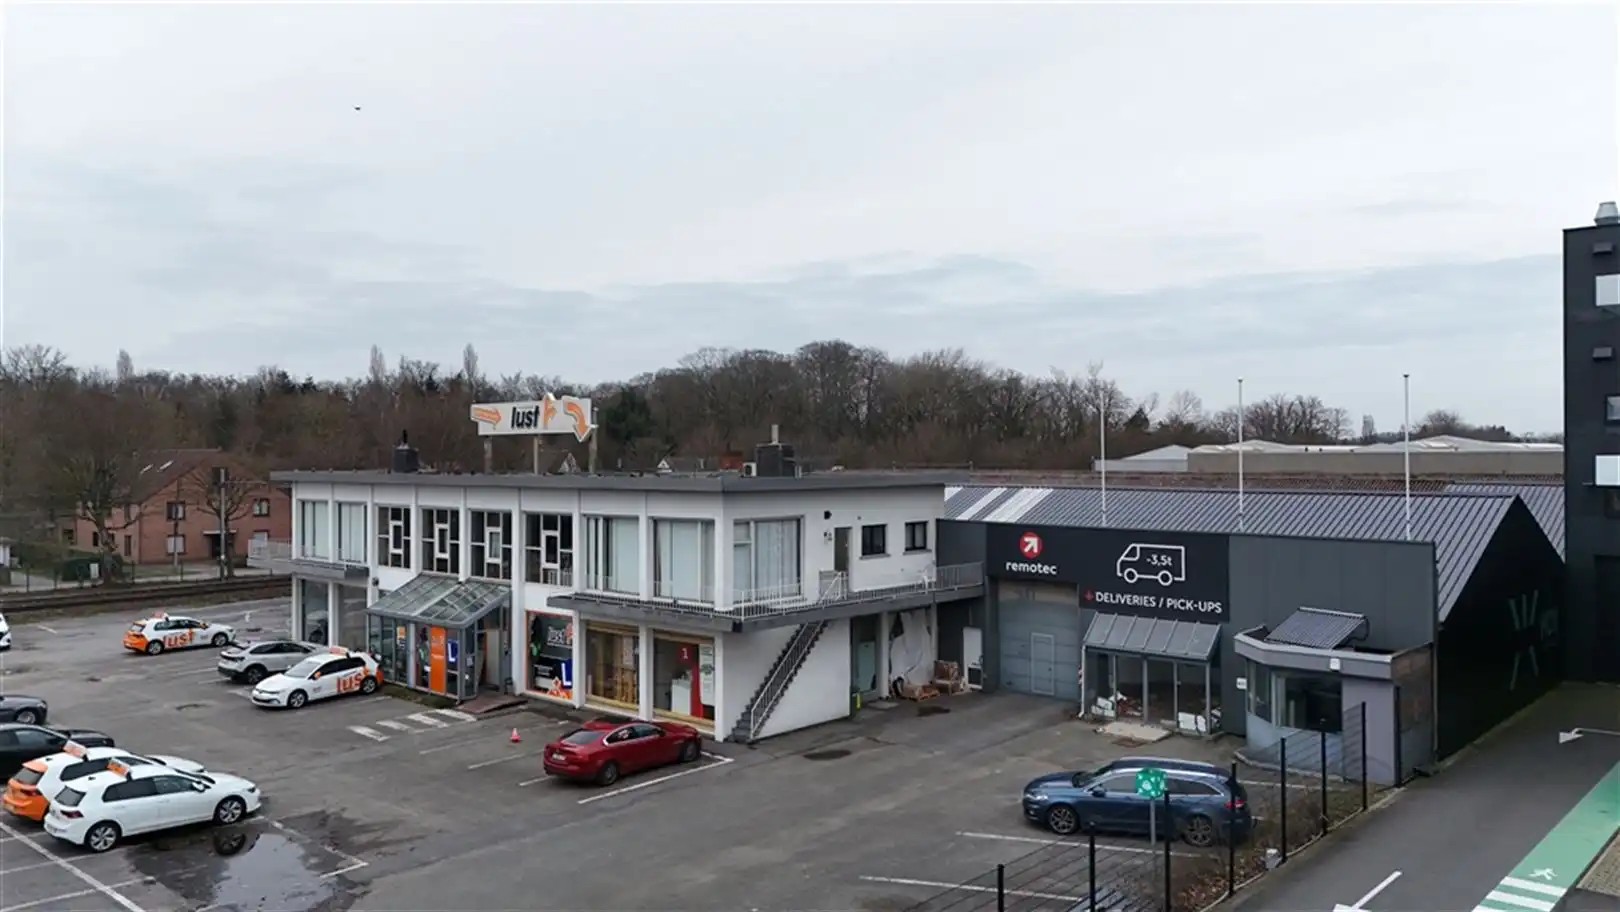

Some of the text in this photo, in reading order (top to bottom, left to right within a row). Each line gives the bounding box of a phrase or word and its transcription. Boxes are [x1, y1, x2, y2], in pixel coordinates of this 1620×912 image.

[510, 405, 539, 429] lust
[1006, 562, 1057, 575] remotec
[1146, 554, 1172, 566] -3,5t
[1096, 592, 1156, 607] DELIVERIES
[1167, 598, 1222, 613] PICK-UPS
[163, 628, 194, 648] lust
